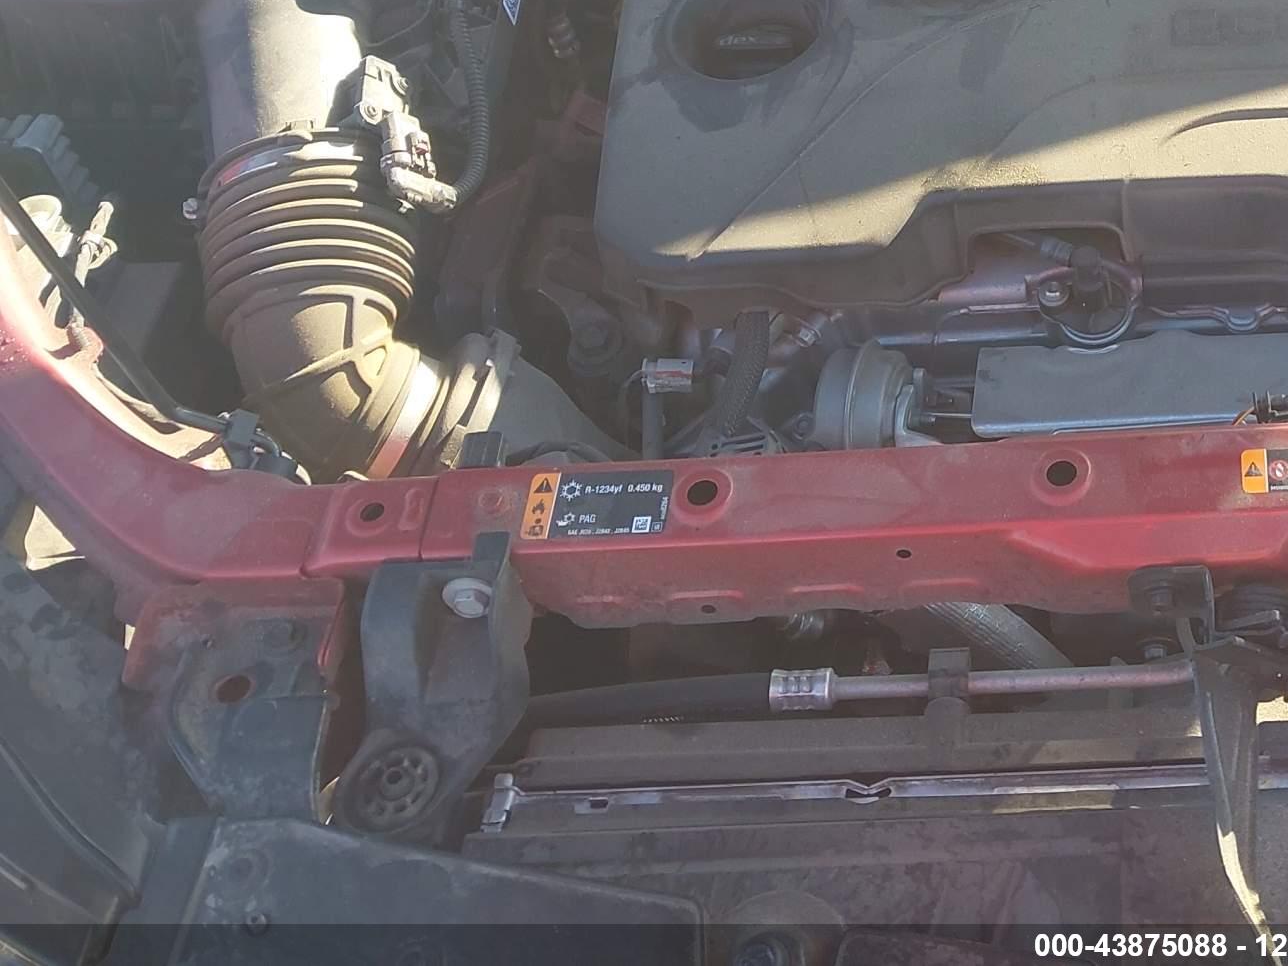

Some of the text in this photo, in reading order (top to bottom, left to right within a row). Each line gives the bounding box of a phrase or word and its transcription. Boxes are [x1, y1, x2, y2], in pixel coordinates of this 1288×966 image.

[585, 482, 663, 495] R-1234yf 0.450 kg
[579, 514, 596, 523] PAG
